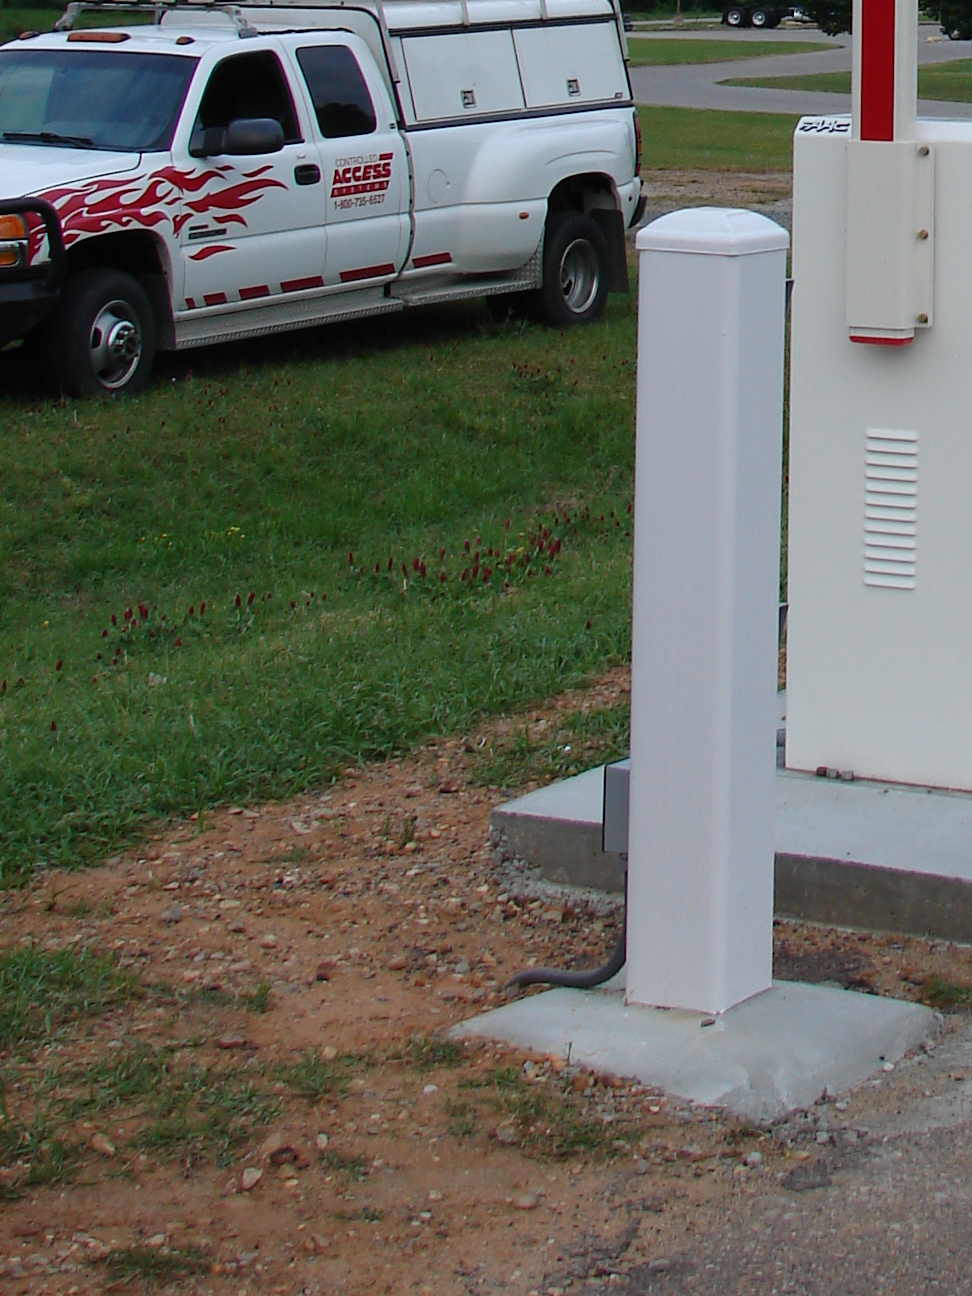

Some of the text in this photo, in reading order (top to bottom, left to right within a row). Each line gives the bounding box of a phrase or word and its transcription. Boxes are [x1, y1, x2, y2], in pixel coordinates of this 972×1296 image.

[335, 154, 378, 167] CONTROLLED
[333, 162, 391, 185] ACCESS
[333, 182, 388, 195] SYSTEMS
